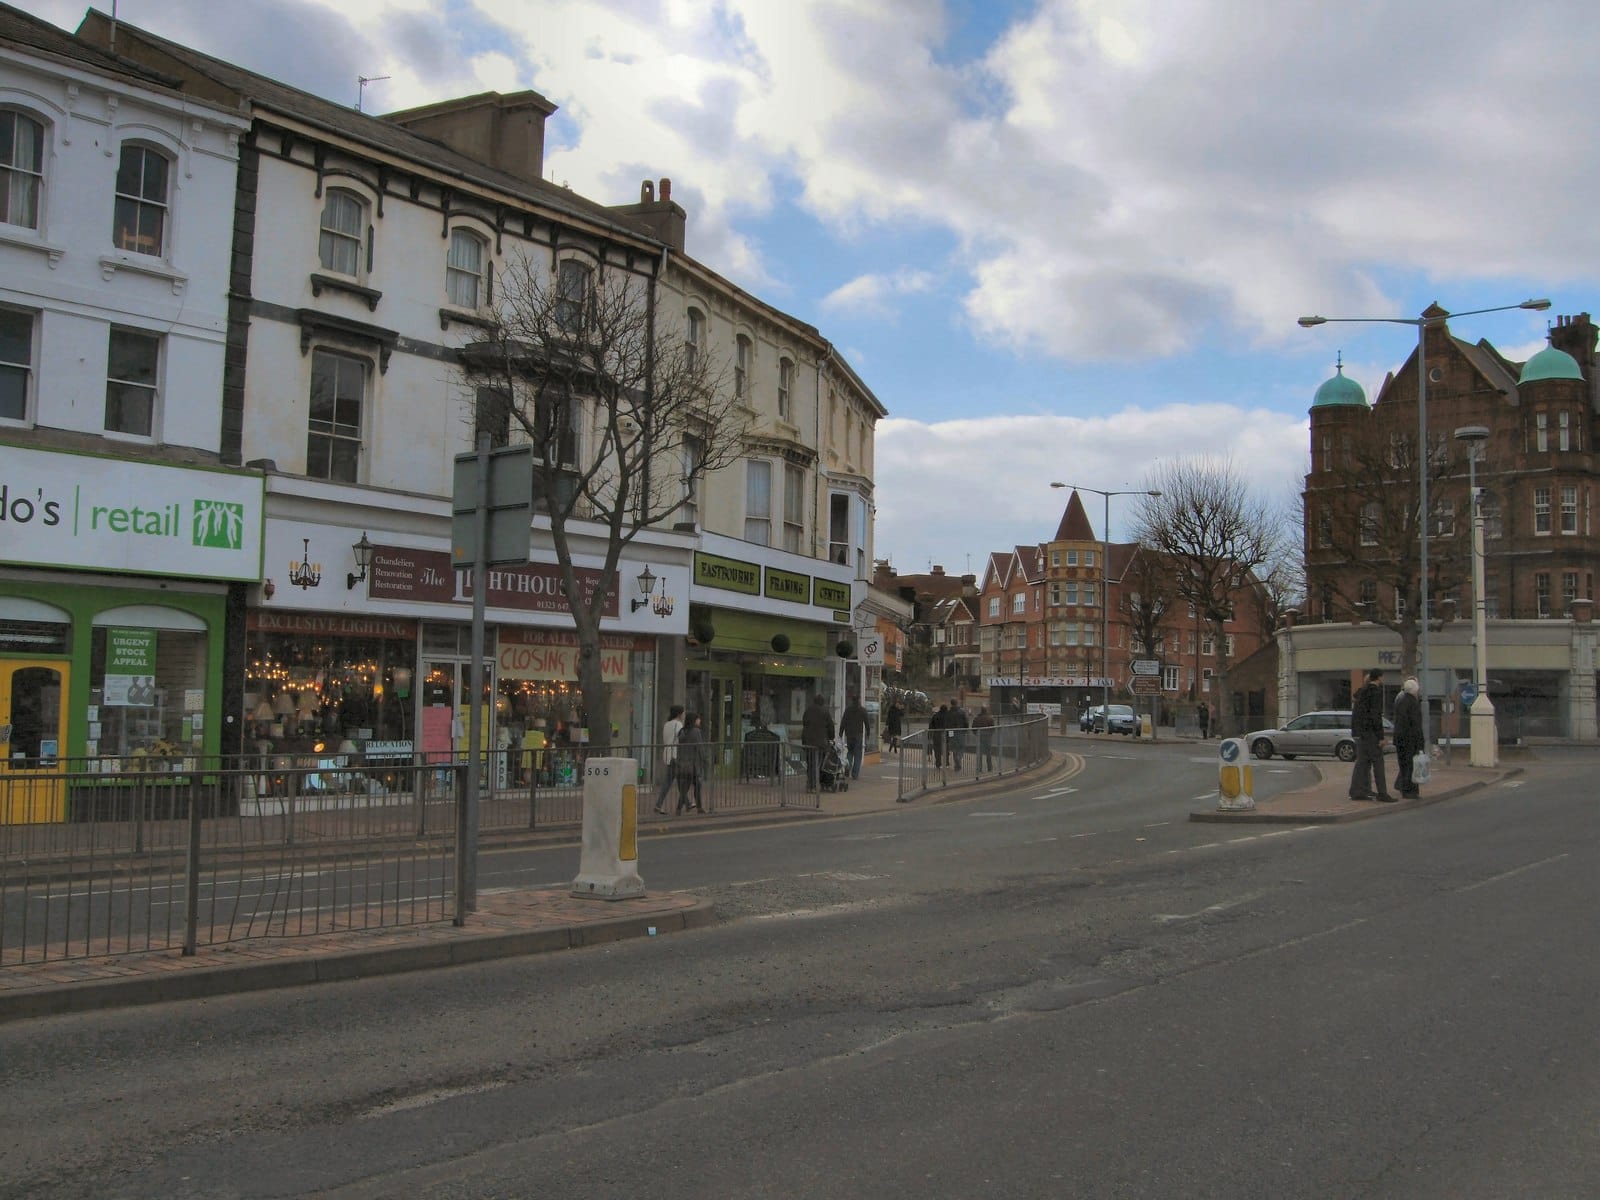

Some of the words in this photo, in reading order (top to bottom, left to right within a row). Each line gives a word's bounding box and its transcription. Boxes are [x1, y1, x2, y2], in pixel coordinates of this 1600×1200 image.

[91, 504, 179, 537] retail
[375, 556, 415, 568] Chandeliers
[375, 568, 413, 579] Renovation
[419, 567, 446, 587] The
[375, 580, 413, 592] Restoration
[700, 562, 755, 586] EASTBOURNE
[769, 577, 803, 596] FRAMING
[819, 586, 845, 603] CENTRE
[537, 601, 556, 610] 01323
[257, 613, 338, 632] EXCLUSIVE
[341, 618, 406, 637] LIGHTING
[113, 638, 150, 647] URGENT
[523, 631, 544, 643] FOR
[548, 633, 569, 645] ALL
[602, 635, 634, 648] NEEDS
[116, 648, 146, 656] STOCK
[112, 657, 149, 666] APPEAL
[500, 647, 568, 676] CLOSING
[990, 678, 1010, 686] TAXI
